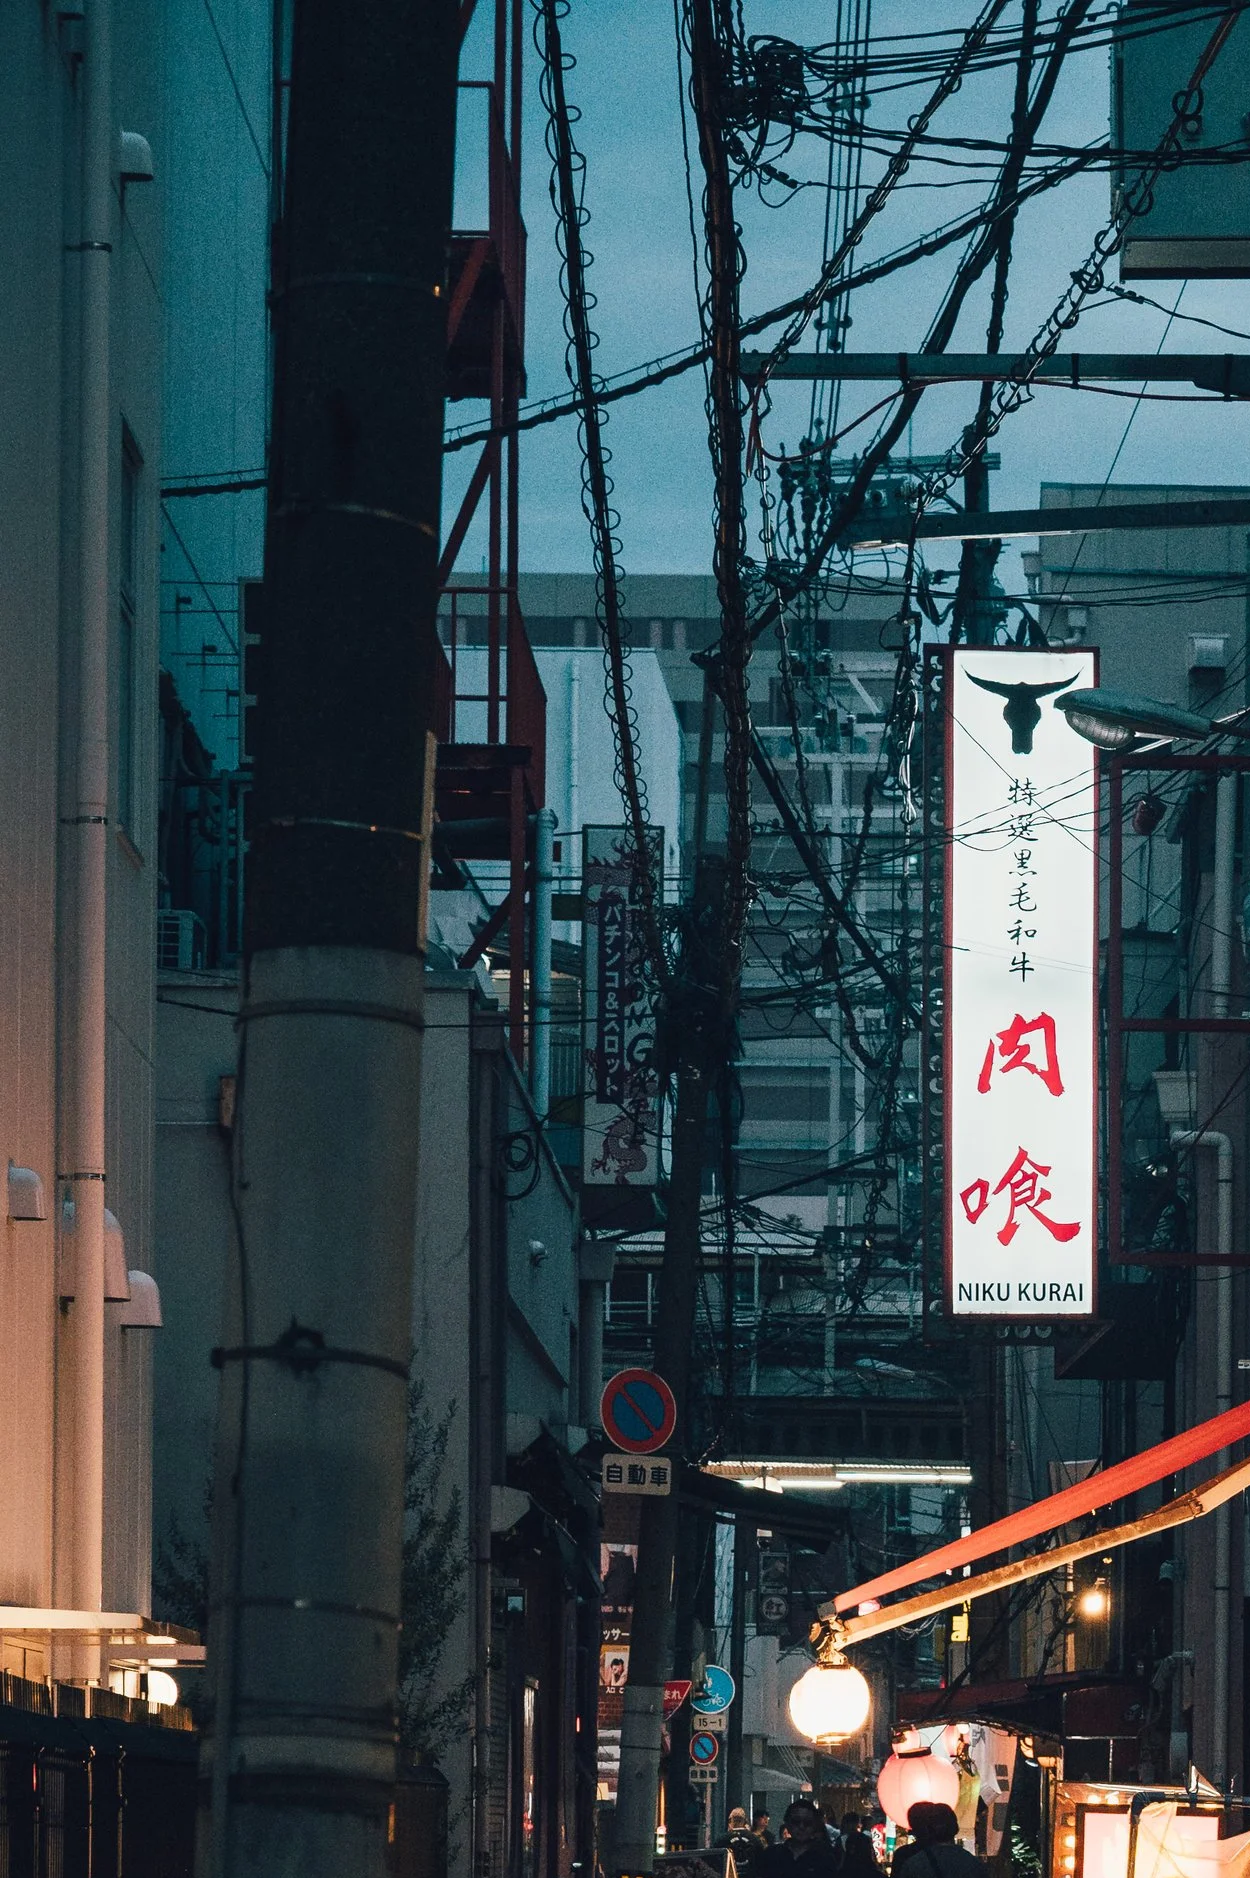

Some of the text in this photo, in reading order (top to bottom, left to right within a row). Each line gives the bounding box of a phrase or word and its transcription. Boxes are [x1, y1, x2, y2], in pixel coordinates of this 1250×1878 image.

[1006, 777, 1038, 984] 特選黒毛和牛
[959, 1010, 1082, 1247] 肉喰
[958, 1281, 1084, 1302] NIKU KURAI
[606, 1463, 668, 1487] 自動車
[697, 1718, 722, 1728] 15-1
